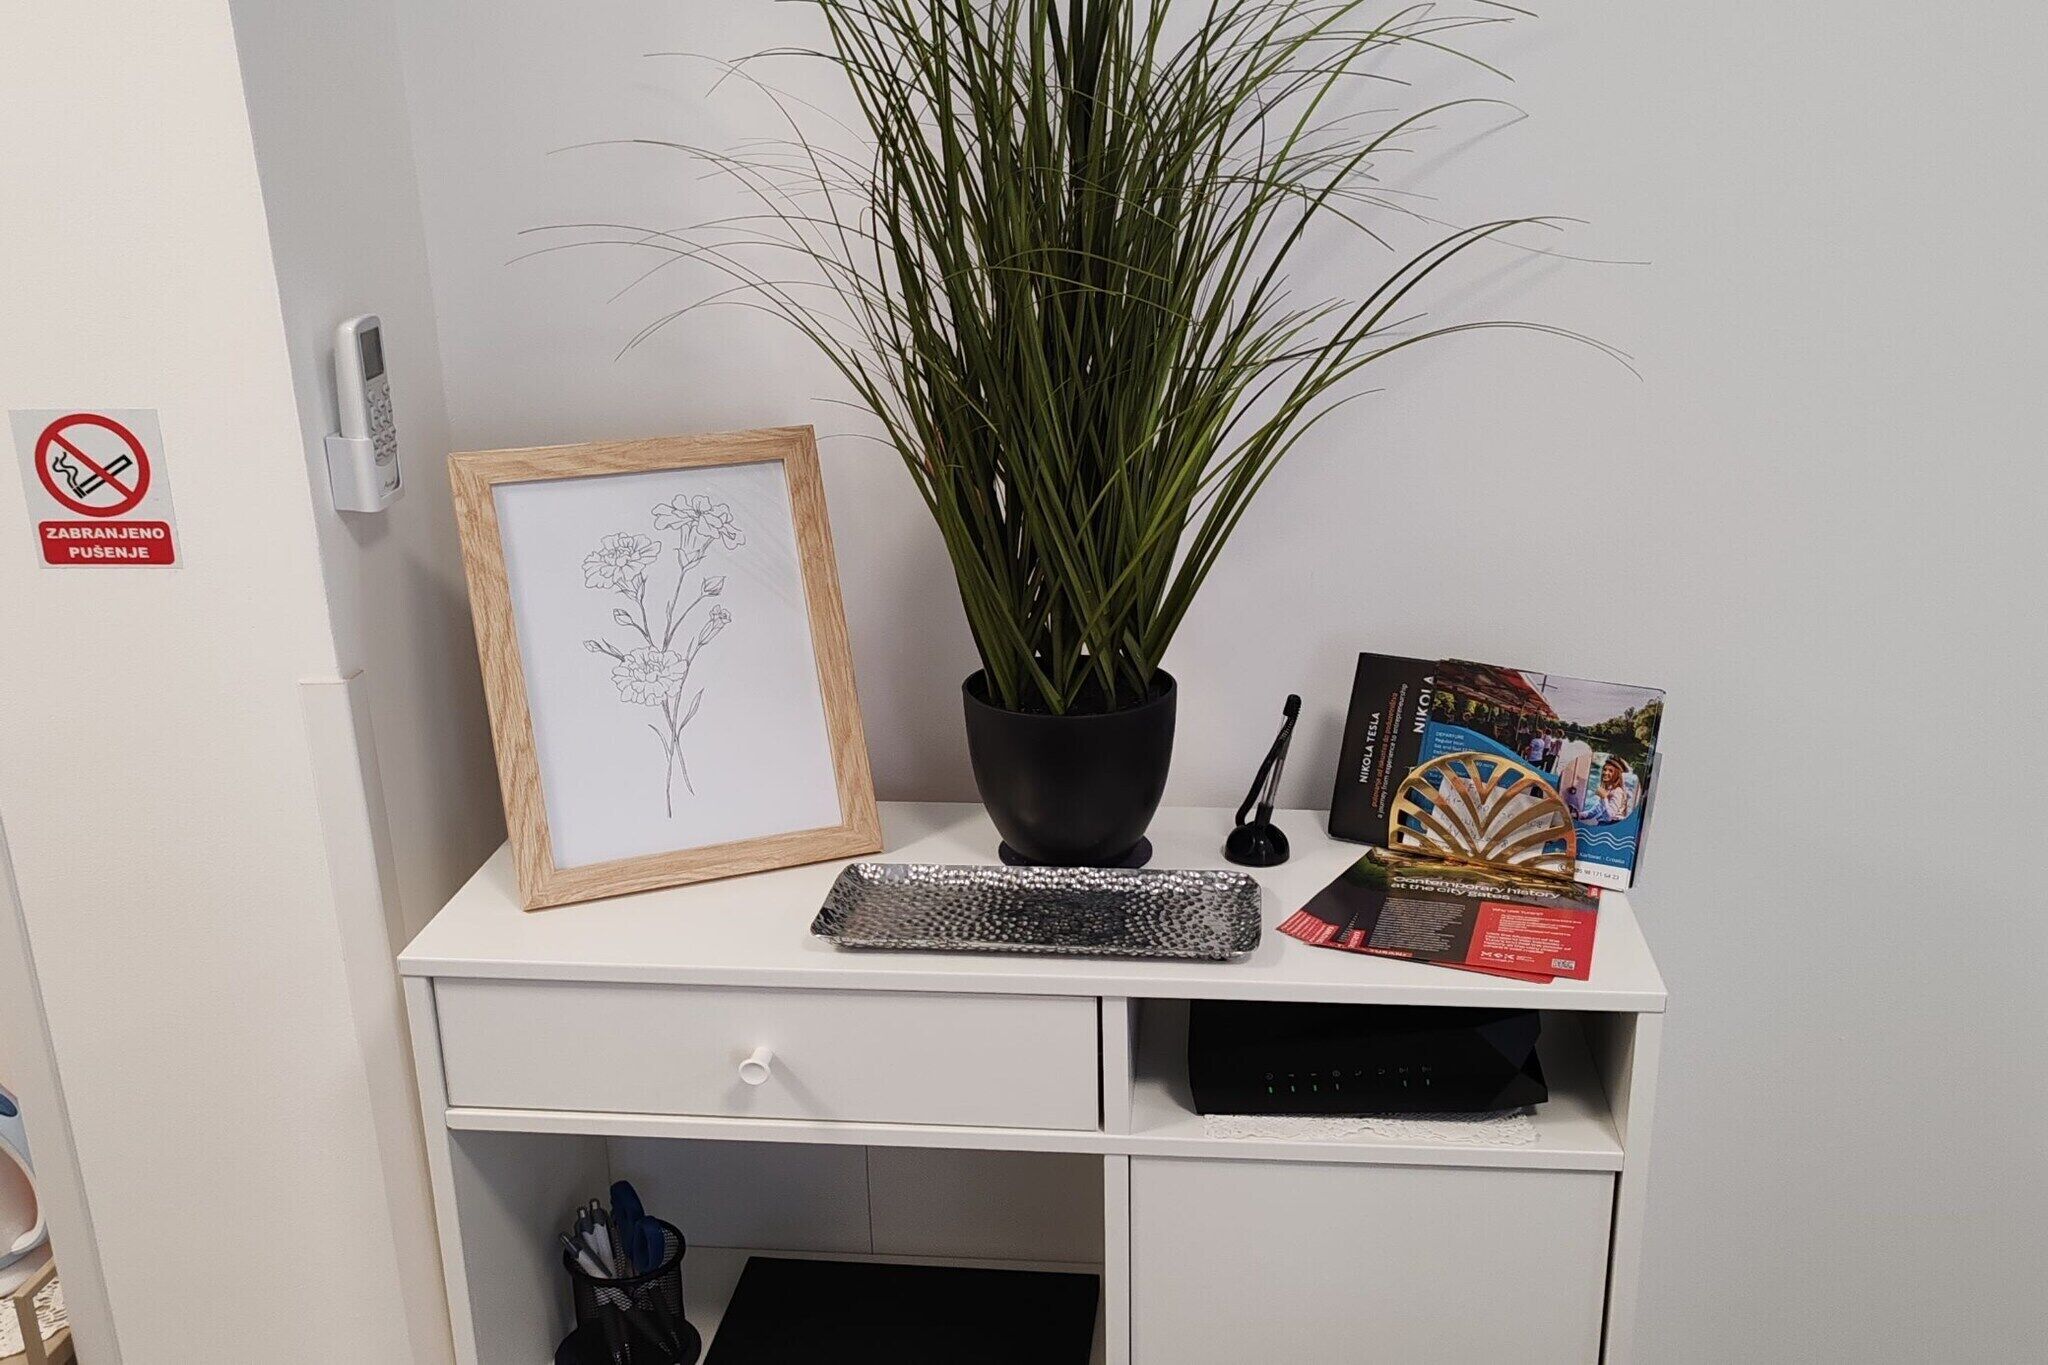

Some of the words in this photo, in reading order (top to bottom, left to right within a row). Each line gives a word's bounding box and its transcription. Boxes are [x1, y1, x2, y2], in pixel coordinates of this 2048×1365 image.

[46, 527, 165, 539] ZABRANJENO
[69, 545, 150, 558] PUŠENJE
[1359, 745, 1374, 783] NIKOLA
[1367, 712, 1380, 743] TESLA
[1390, 882, 1405, 890] at
[1409, 882, 1434, 892] the
[1436, 885, 1466, 896] city
[1467, 889, 1510, 900] gates
[1393, 876, 1506, 893] Contemporary
[1506, 886, 1561, 899] history
